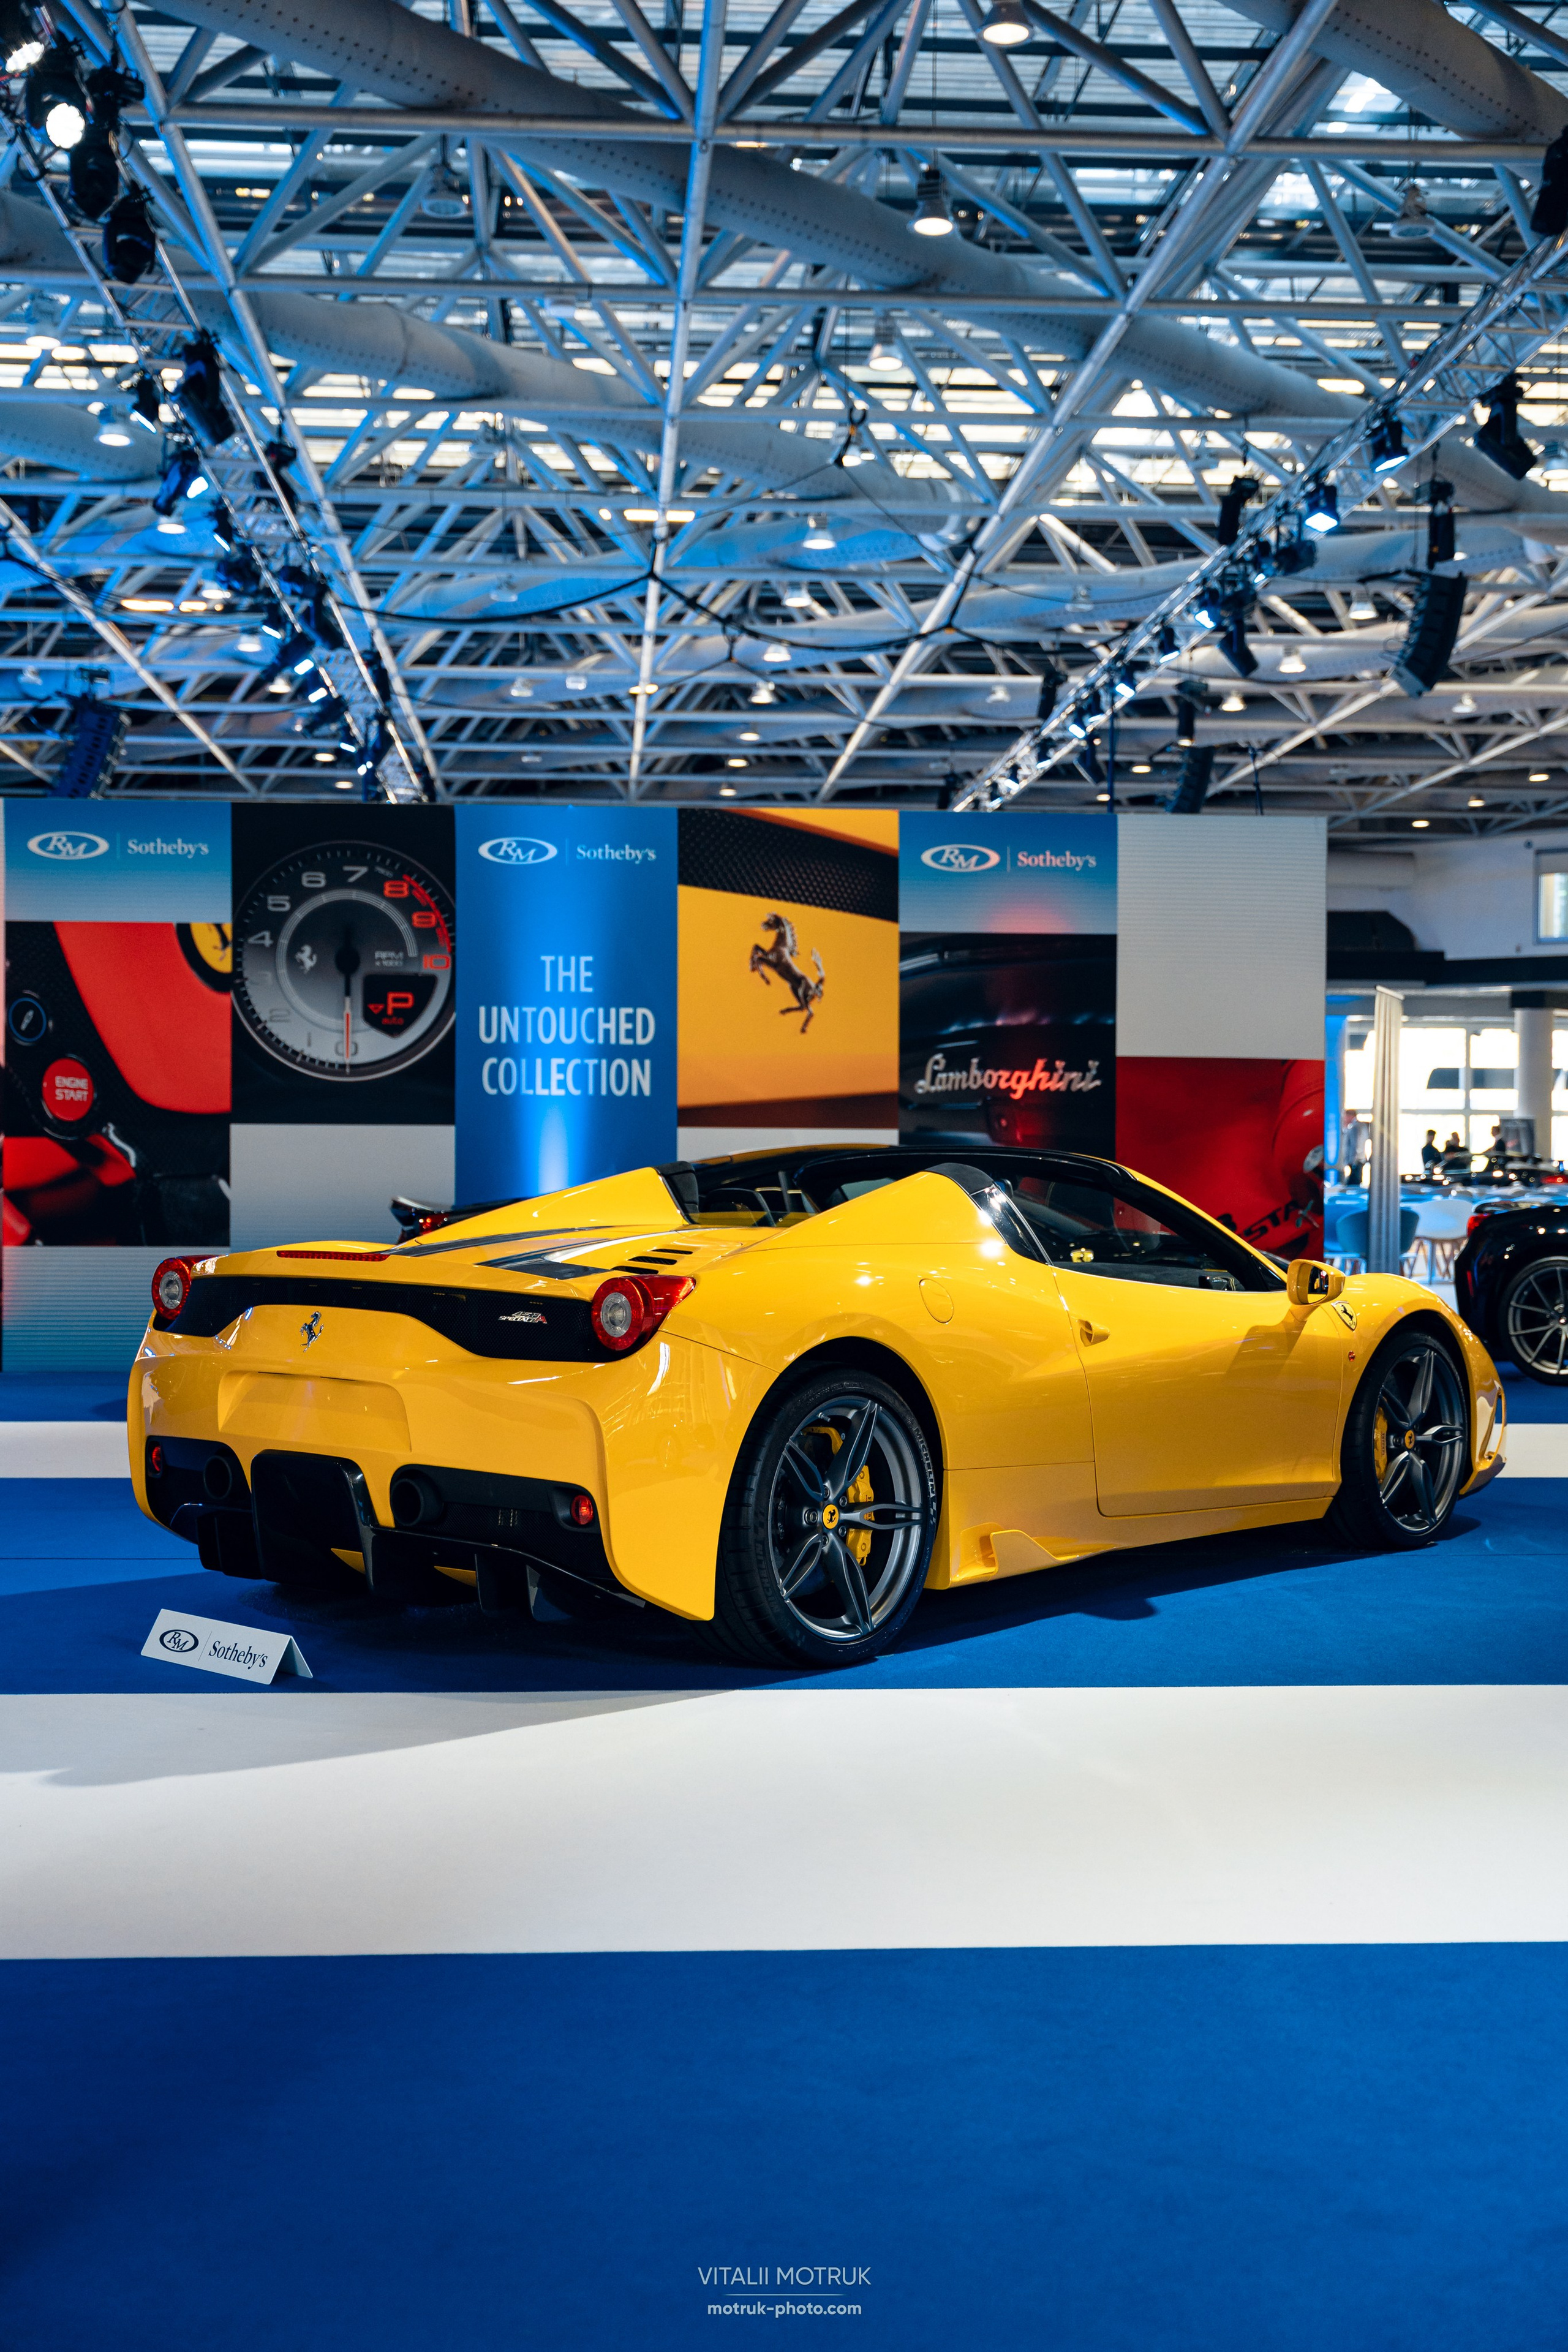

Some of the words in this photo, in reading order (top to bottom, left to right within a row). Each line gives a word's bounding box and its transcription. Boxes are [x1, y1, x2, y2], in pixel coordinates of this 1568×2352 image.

[127, 837, 209, 859] Sotheby's
[576, 843, 657, 864] Sotheby's
[1017, 850, 1097, 872] Sotheby's
[301, 871, 326, 888] 6
[342, 865, 369, 883] 7
[383, 880, 409, 899] 8
[266, 894, 292, 912] 5
[247, 930, 274, 948] 4
[423, 954, 451, 970] 10
[540, 956, 594, 992] THE
[386, 992, 415, 1016] P
[478, 1006, 656, 1046] UNTOUCHED
[55, 1075, 89, 1090] ENGINE
[482, 1057, 652, 1097] COLLECTION
[914, 1053, 1102, 1100] Lamborghini
[55, 1088, 89, 1102] START
[913, 1426, 936, 1499] MICHELIN
[208, 1640, 268, 1670] Sotheby's
